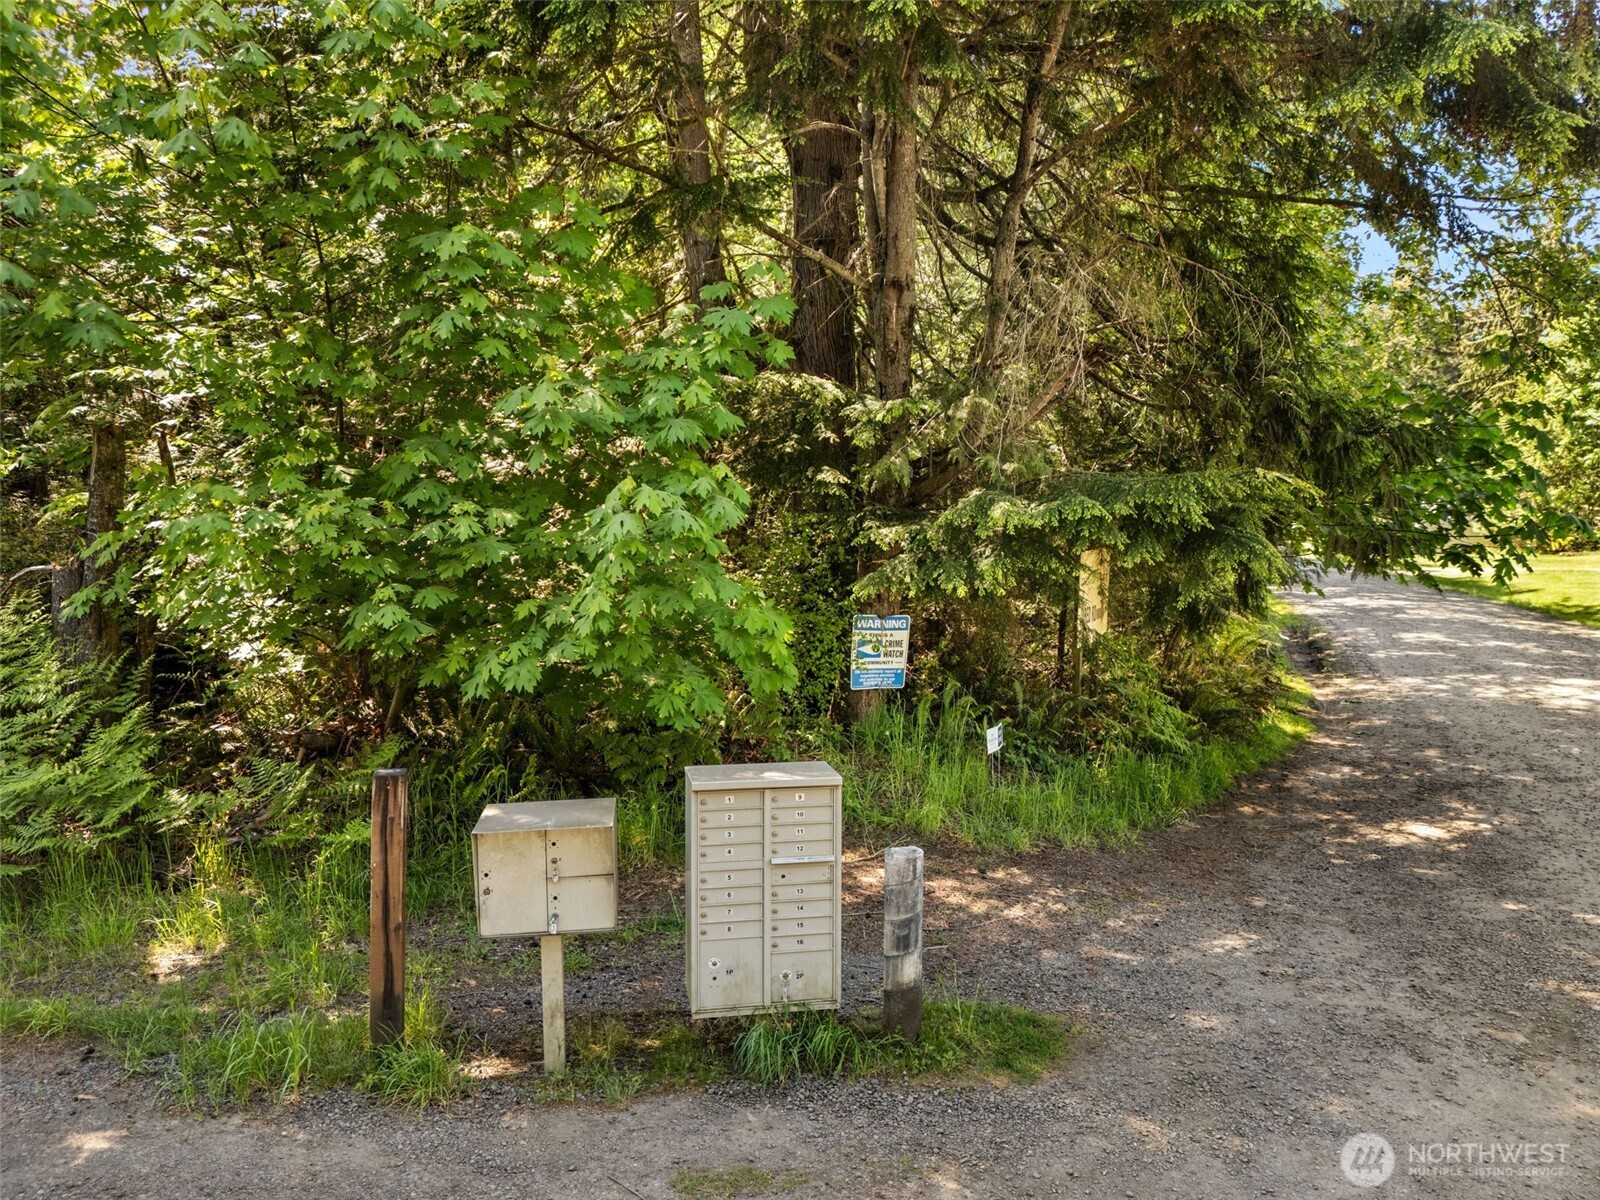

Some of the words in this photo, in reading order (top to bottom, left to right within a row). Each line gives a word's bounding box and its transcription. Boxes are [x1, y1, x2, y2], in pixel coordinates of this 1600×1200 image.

[857, 619, 907, 629] WARNING
[884, 640, 904, 648] CRIME
[883, 649, 904, 658] WATCH
